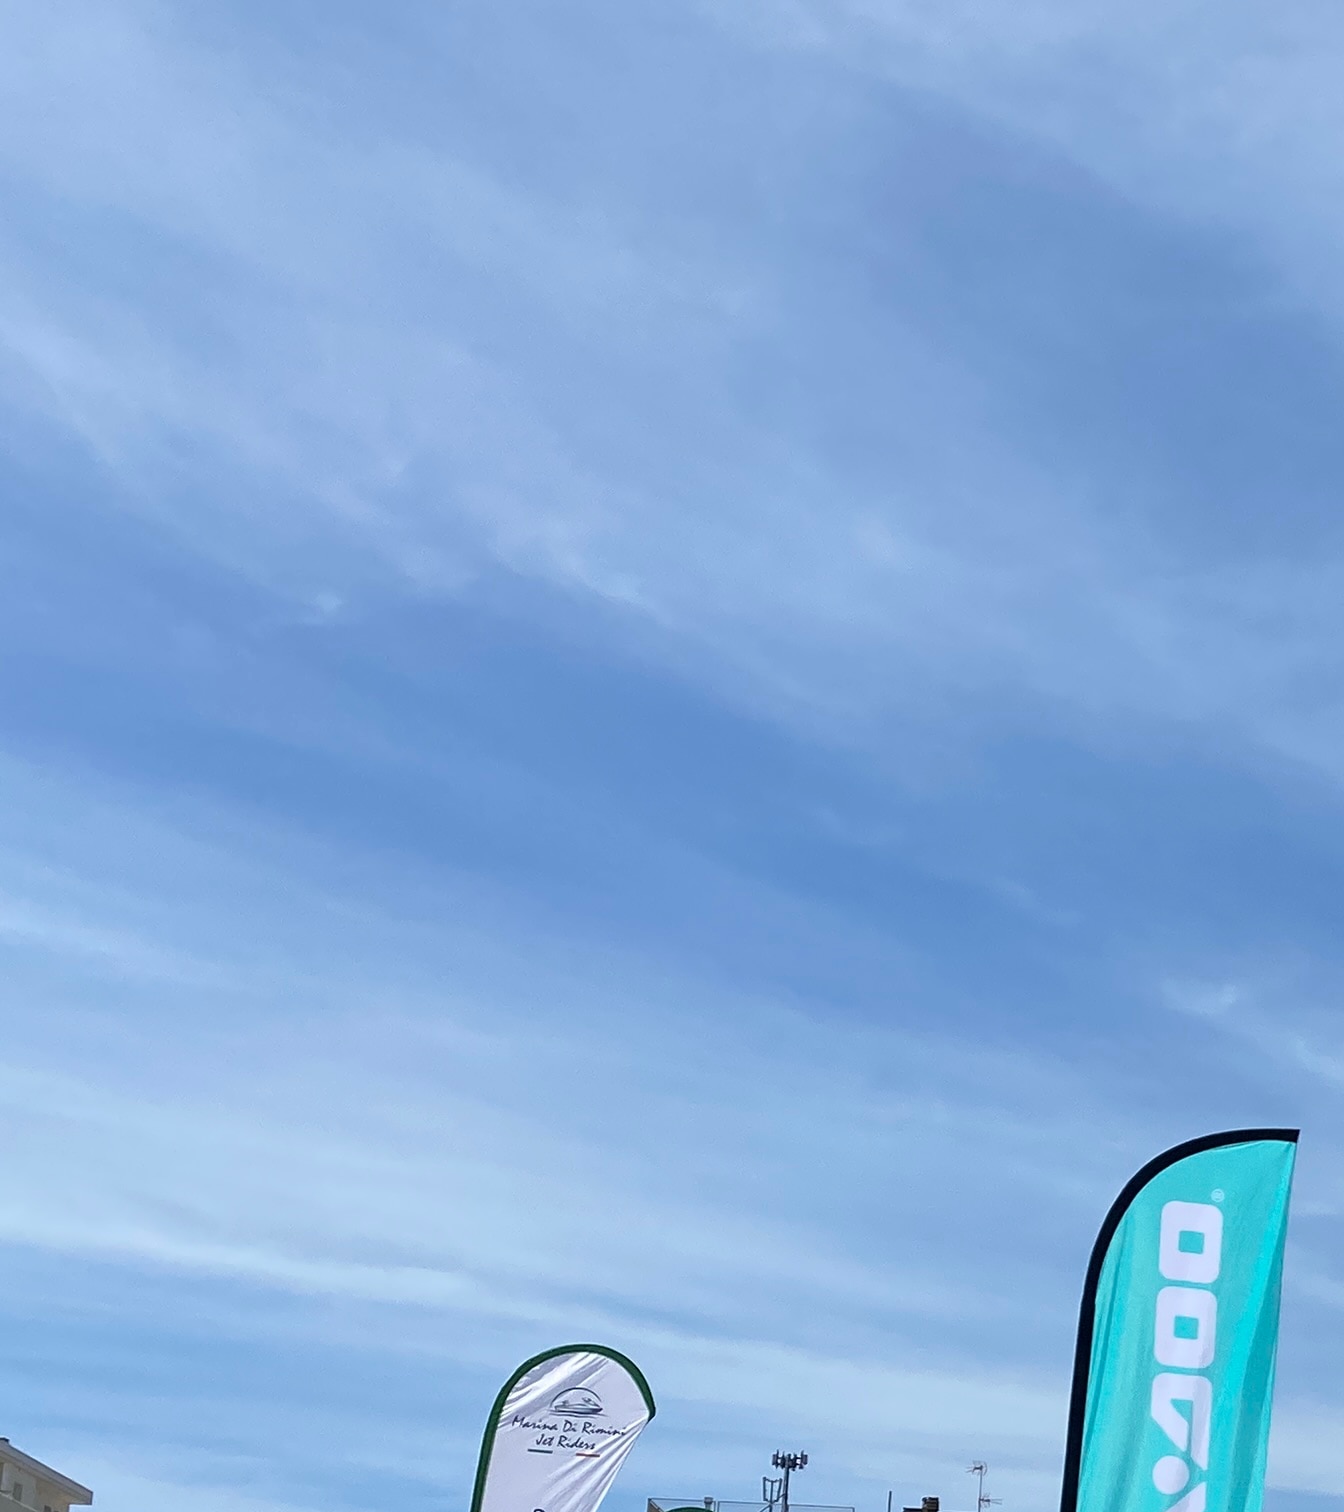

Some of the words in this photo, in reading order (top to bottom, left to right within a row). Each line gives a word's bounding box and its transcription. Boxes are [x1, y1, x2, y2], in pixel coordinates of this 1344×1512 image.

[511, 1414, 558, 1431] Marina
[562, 1419, 578, 1432] Di
[582, 1422, 627, 1436] Rimini
[536, 1433, 554, 1447] Jet
[556, 1435, 596, 1450] Riders
